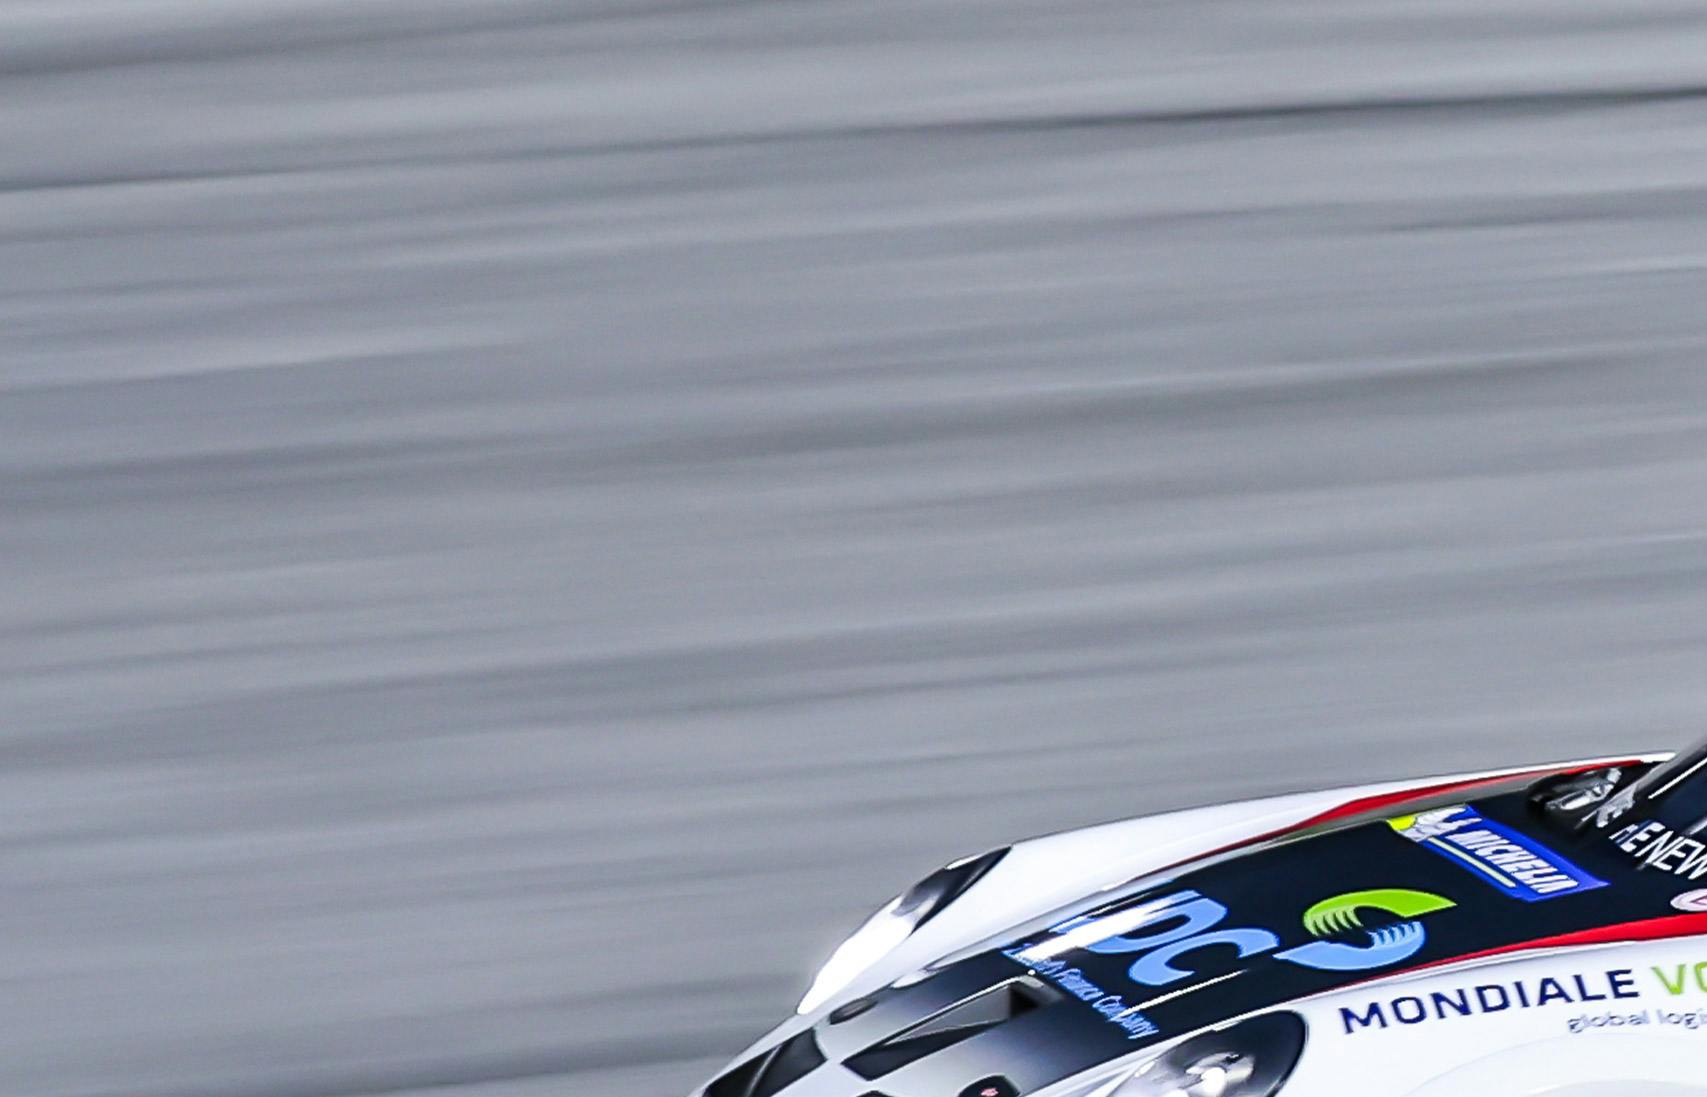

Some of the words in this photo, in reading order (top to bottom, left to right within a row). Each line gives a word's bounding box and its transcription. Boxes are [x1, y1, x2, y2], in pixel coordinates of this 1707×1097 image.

[1444, 829, 1579, 894] MICHELIN
[1338, 968, 1639, 1034] MONDIALE
[1567, 1009, 1649, 1034] global
